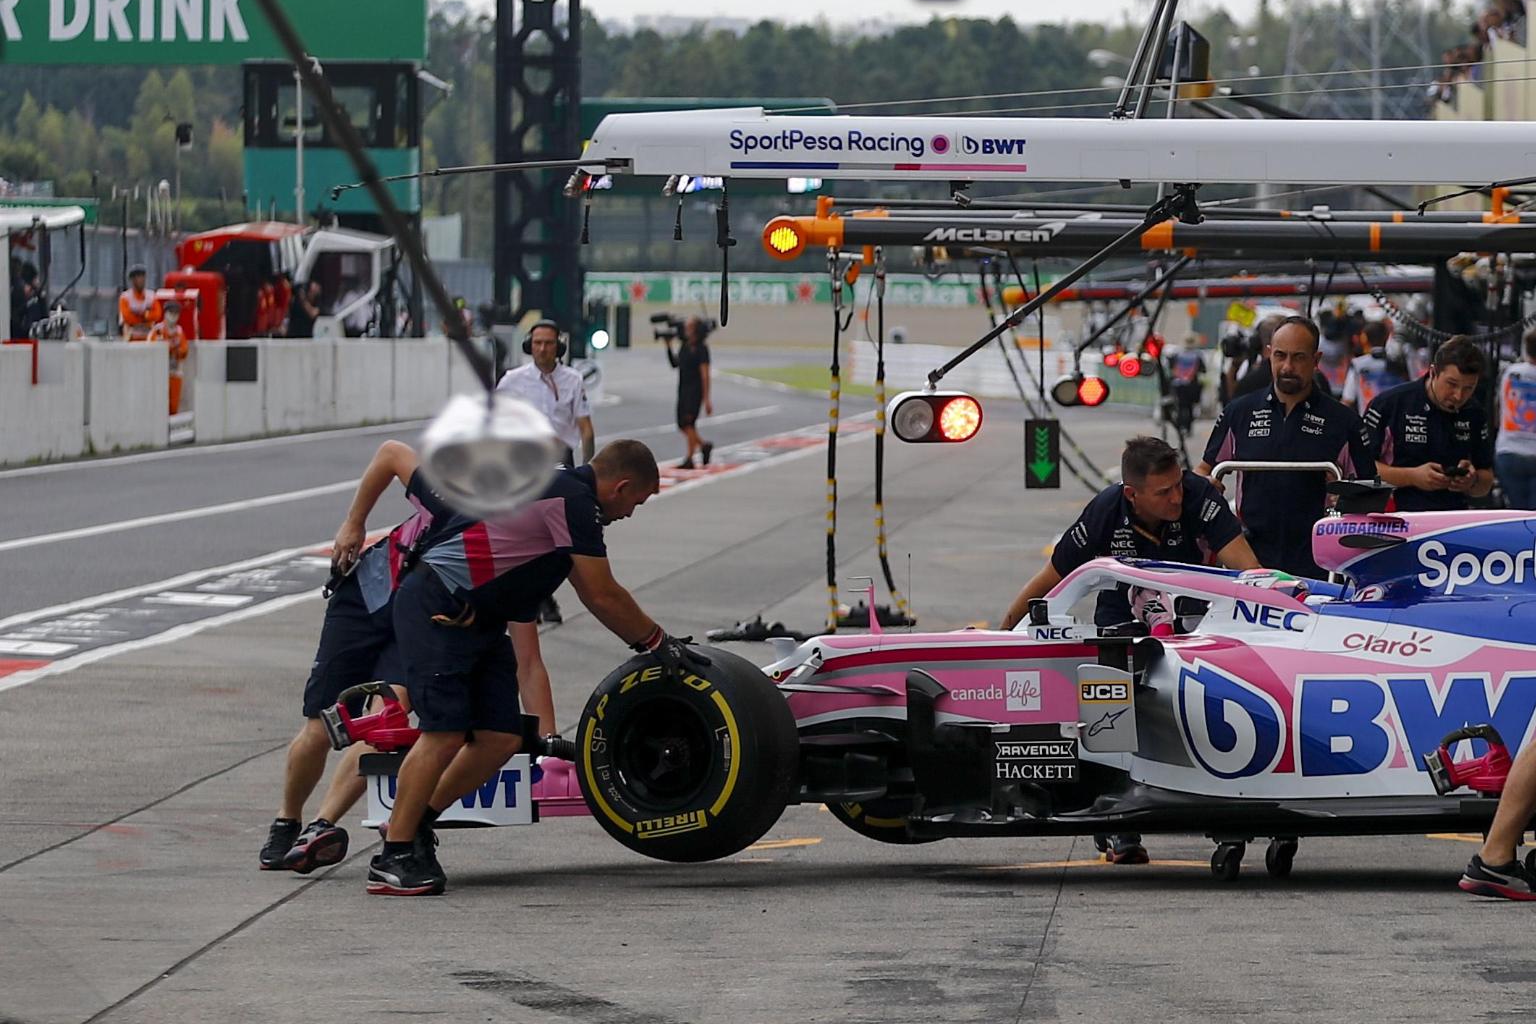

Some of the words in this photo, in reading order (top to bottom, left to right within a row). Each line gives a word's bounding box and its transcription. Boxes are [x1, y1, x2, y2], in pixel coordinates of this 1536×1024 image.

[730, 129, 843, 154] SportPesa
[848, 131, 924, 157] Racing
[982, 139, 1026, 154] BWT
[923, 226, 1050, 242] McLaren
[1316, 520, 1409, 536] BOMBARDIER
[1232, 599, 1309, 633] NEC
[1036, 627, 1072, 640] NEC
[1343, 632, 1419, 657] Claro
[620, 666, 712, 693] ZEO
[951, 684, 1003, 701] canada
[1006, 679, 1041, 706] life
[1083, 684, 1128, 700] JCB
[1001, 745, 1070, 756] RAVENOL
[460, 769, 521, 808] WT
[636, 809, 708, 839] PIRELLI
